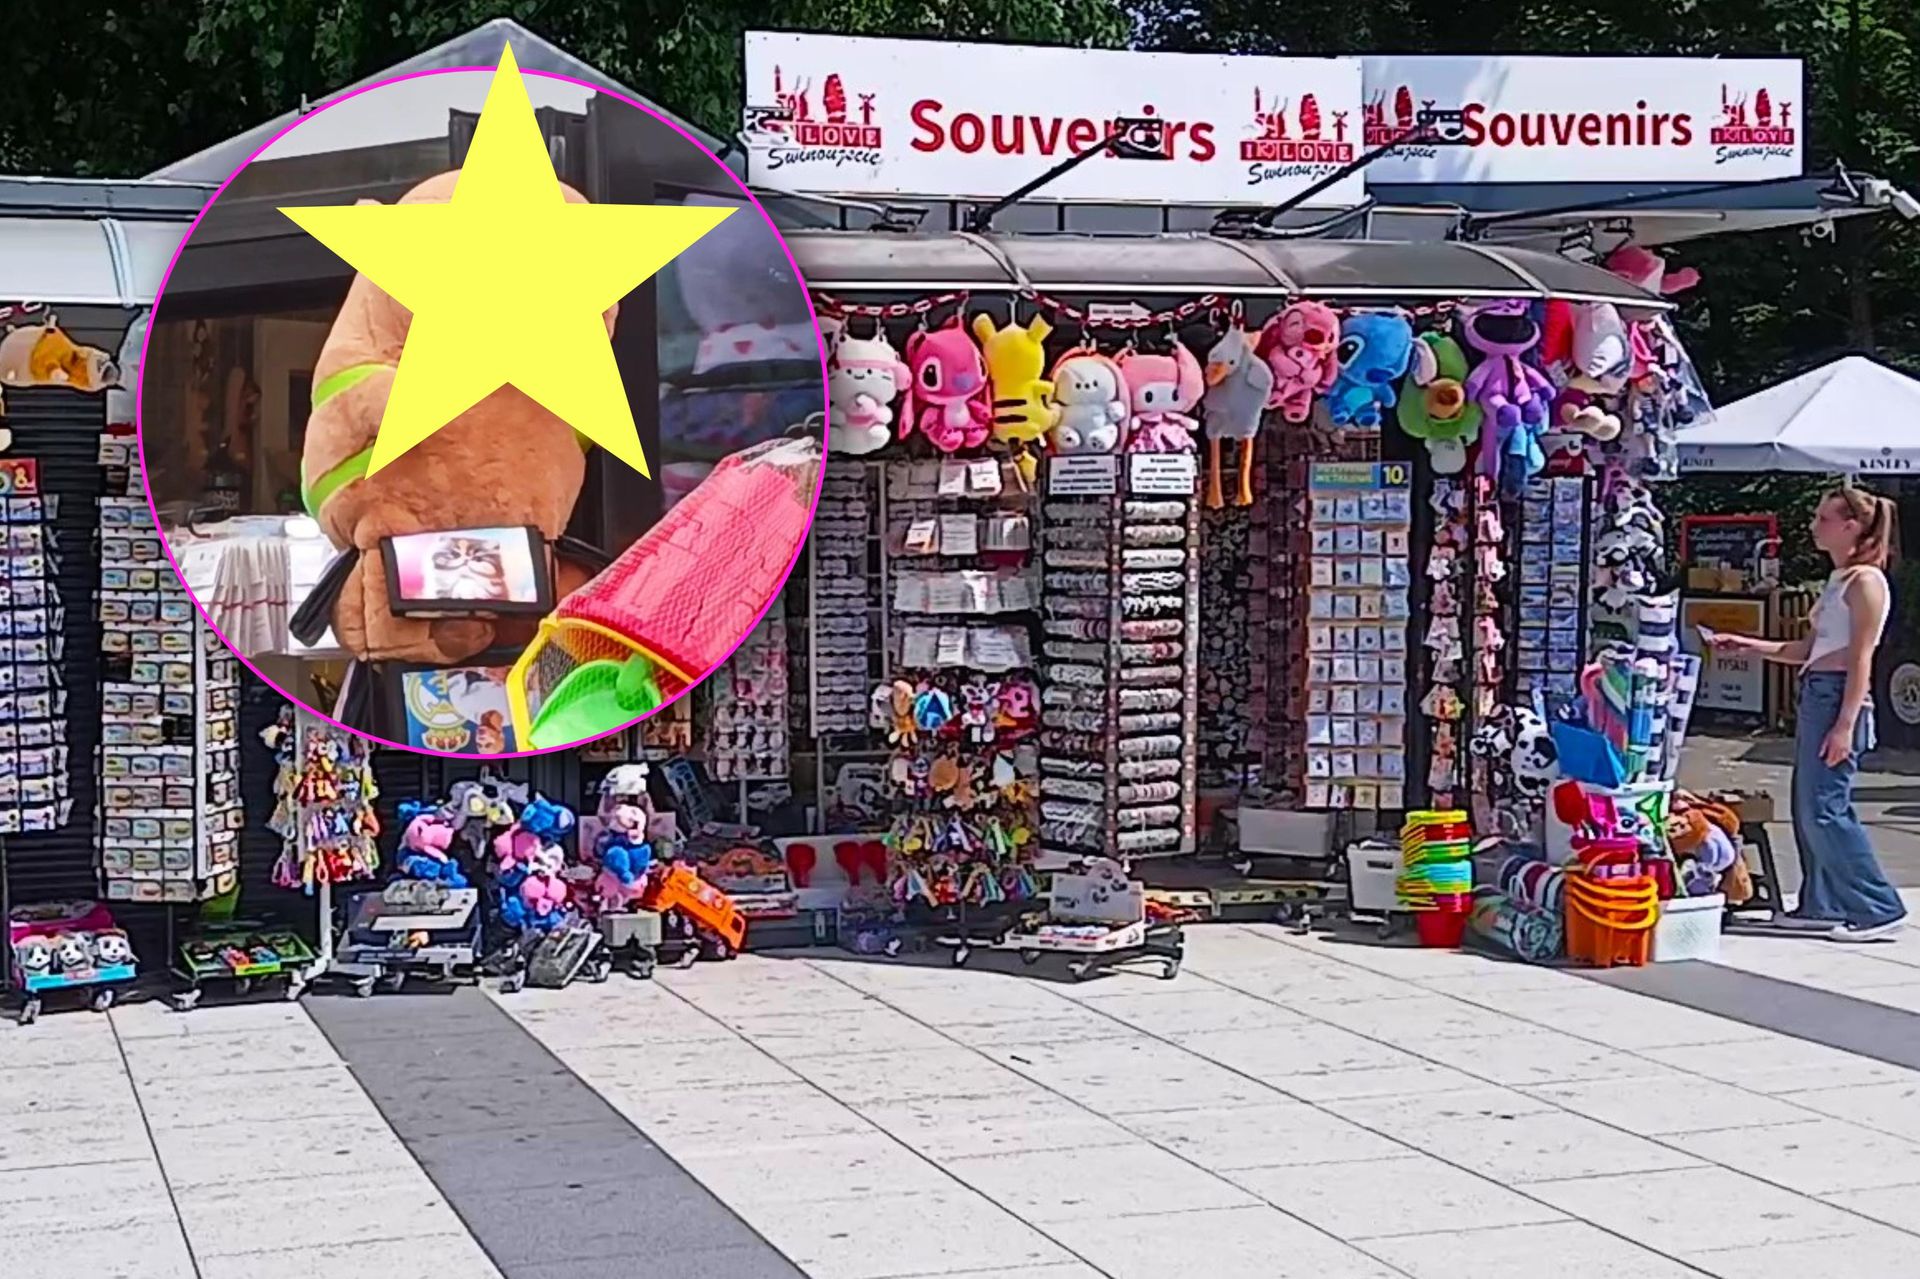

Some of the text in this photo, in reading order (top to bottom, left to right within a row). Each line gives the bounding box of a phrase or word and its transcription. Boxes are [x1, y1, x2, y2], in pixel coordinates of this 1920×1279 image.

[1462, 99, 1692, 147] Souvenirs
[804, 126, 880, 146] LOVE
[1280, 142, 1350, 160] LOVE
